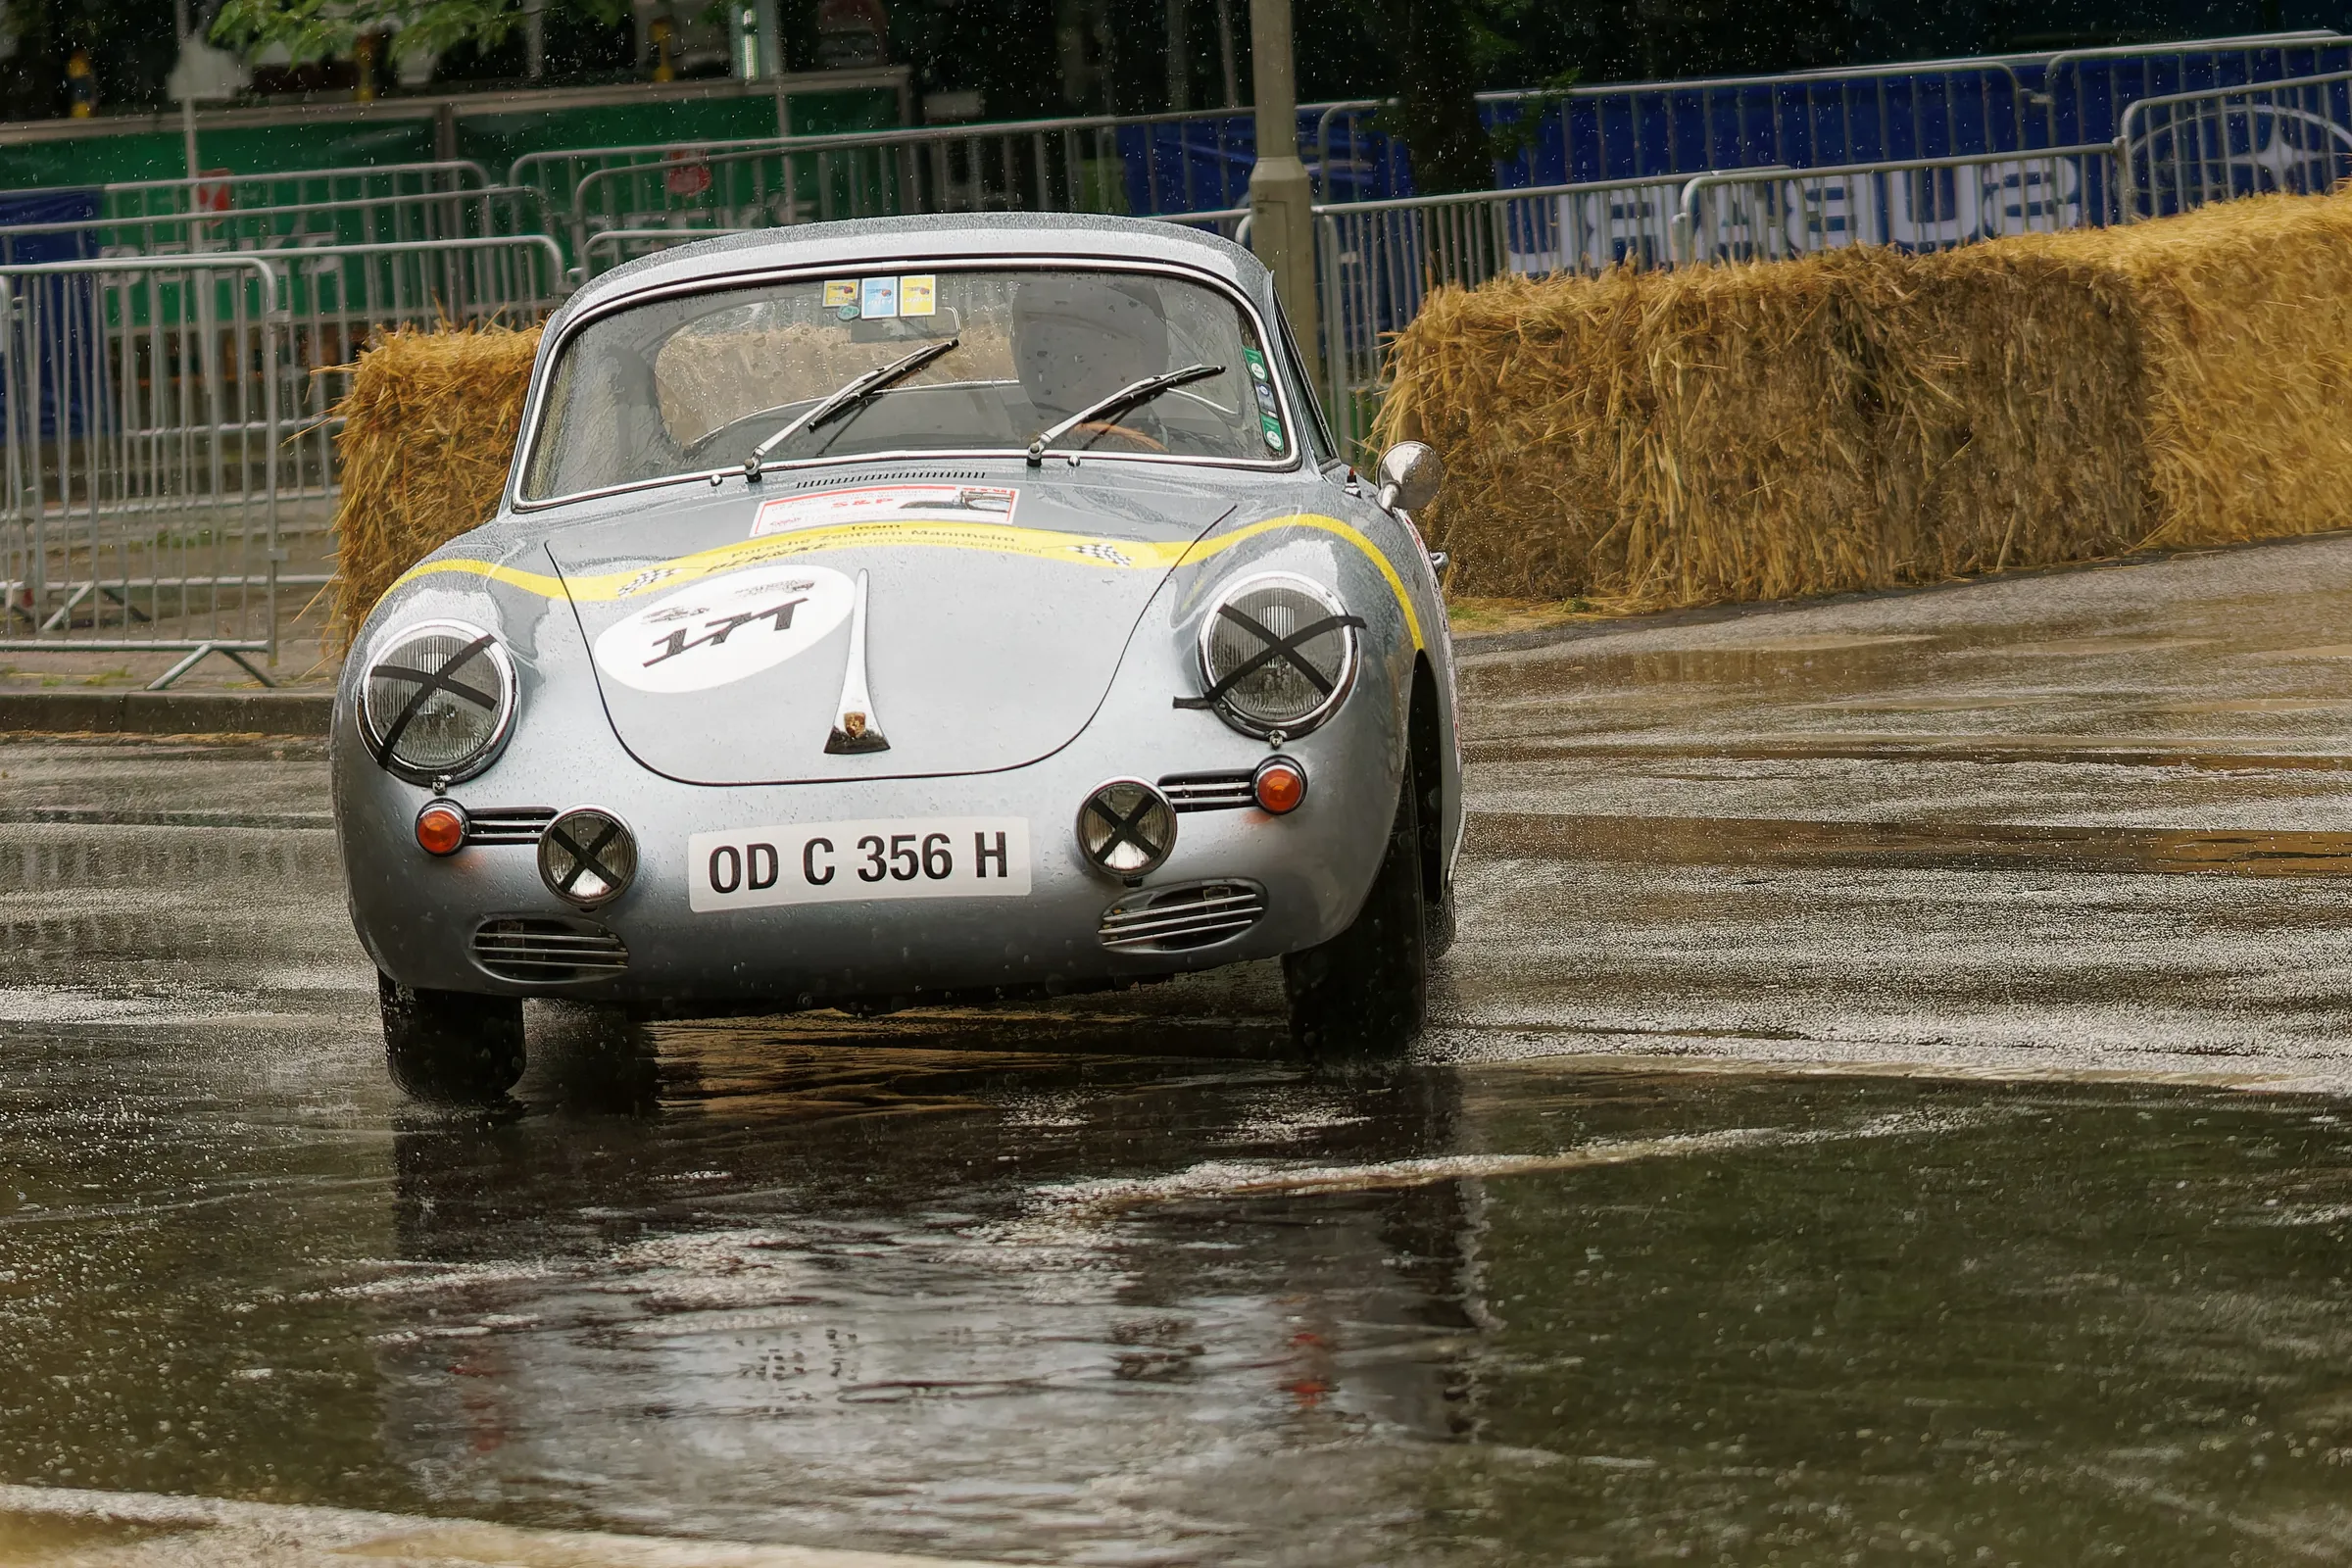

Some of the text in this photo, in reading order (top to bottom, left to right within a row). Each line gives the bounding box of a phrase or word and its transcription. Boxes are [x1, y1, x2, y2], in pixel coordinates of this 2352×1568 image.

[730, 529, 1015, 558] Porsche Zentrum Mannheim
[642, 597, 809, 668] 171
[709, 830, 1007, 894] OD C 356 H
